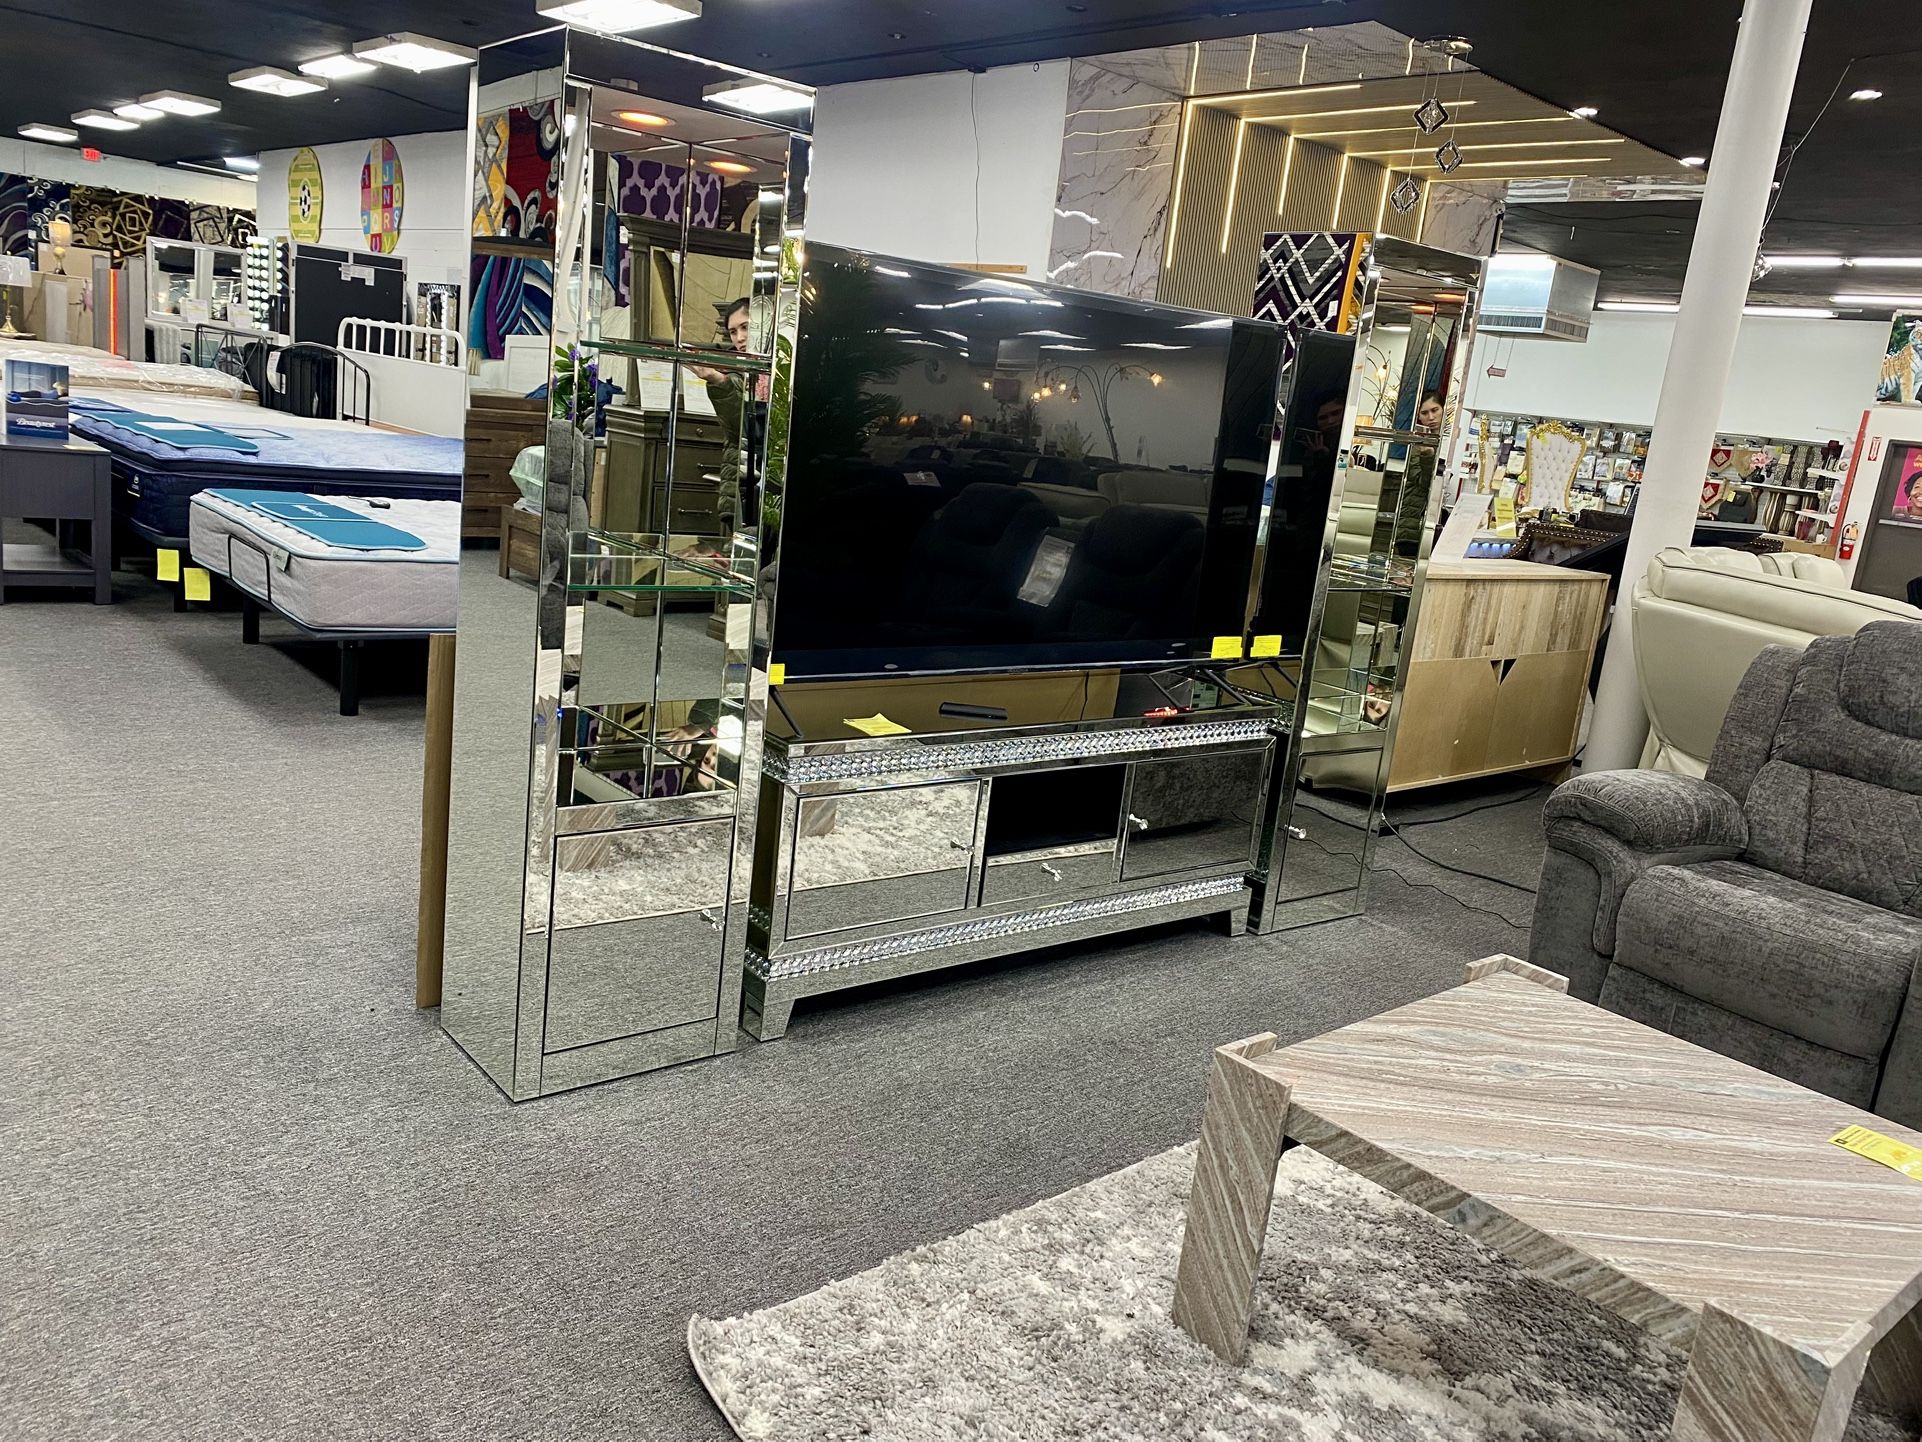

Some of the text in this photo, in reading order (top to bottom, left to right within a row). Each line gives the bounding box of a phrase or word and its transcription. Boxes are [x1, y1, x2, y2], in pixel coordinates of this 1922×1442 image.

[383, 165, 389, 182] J
[383, 188, 390, 205] N
[383, 213, 390, 229] R
[394, 210, 400, 228] S
[372, 237, 380, 252] U
